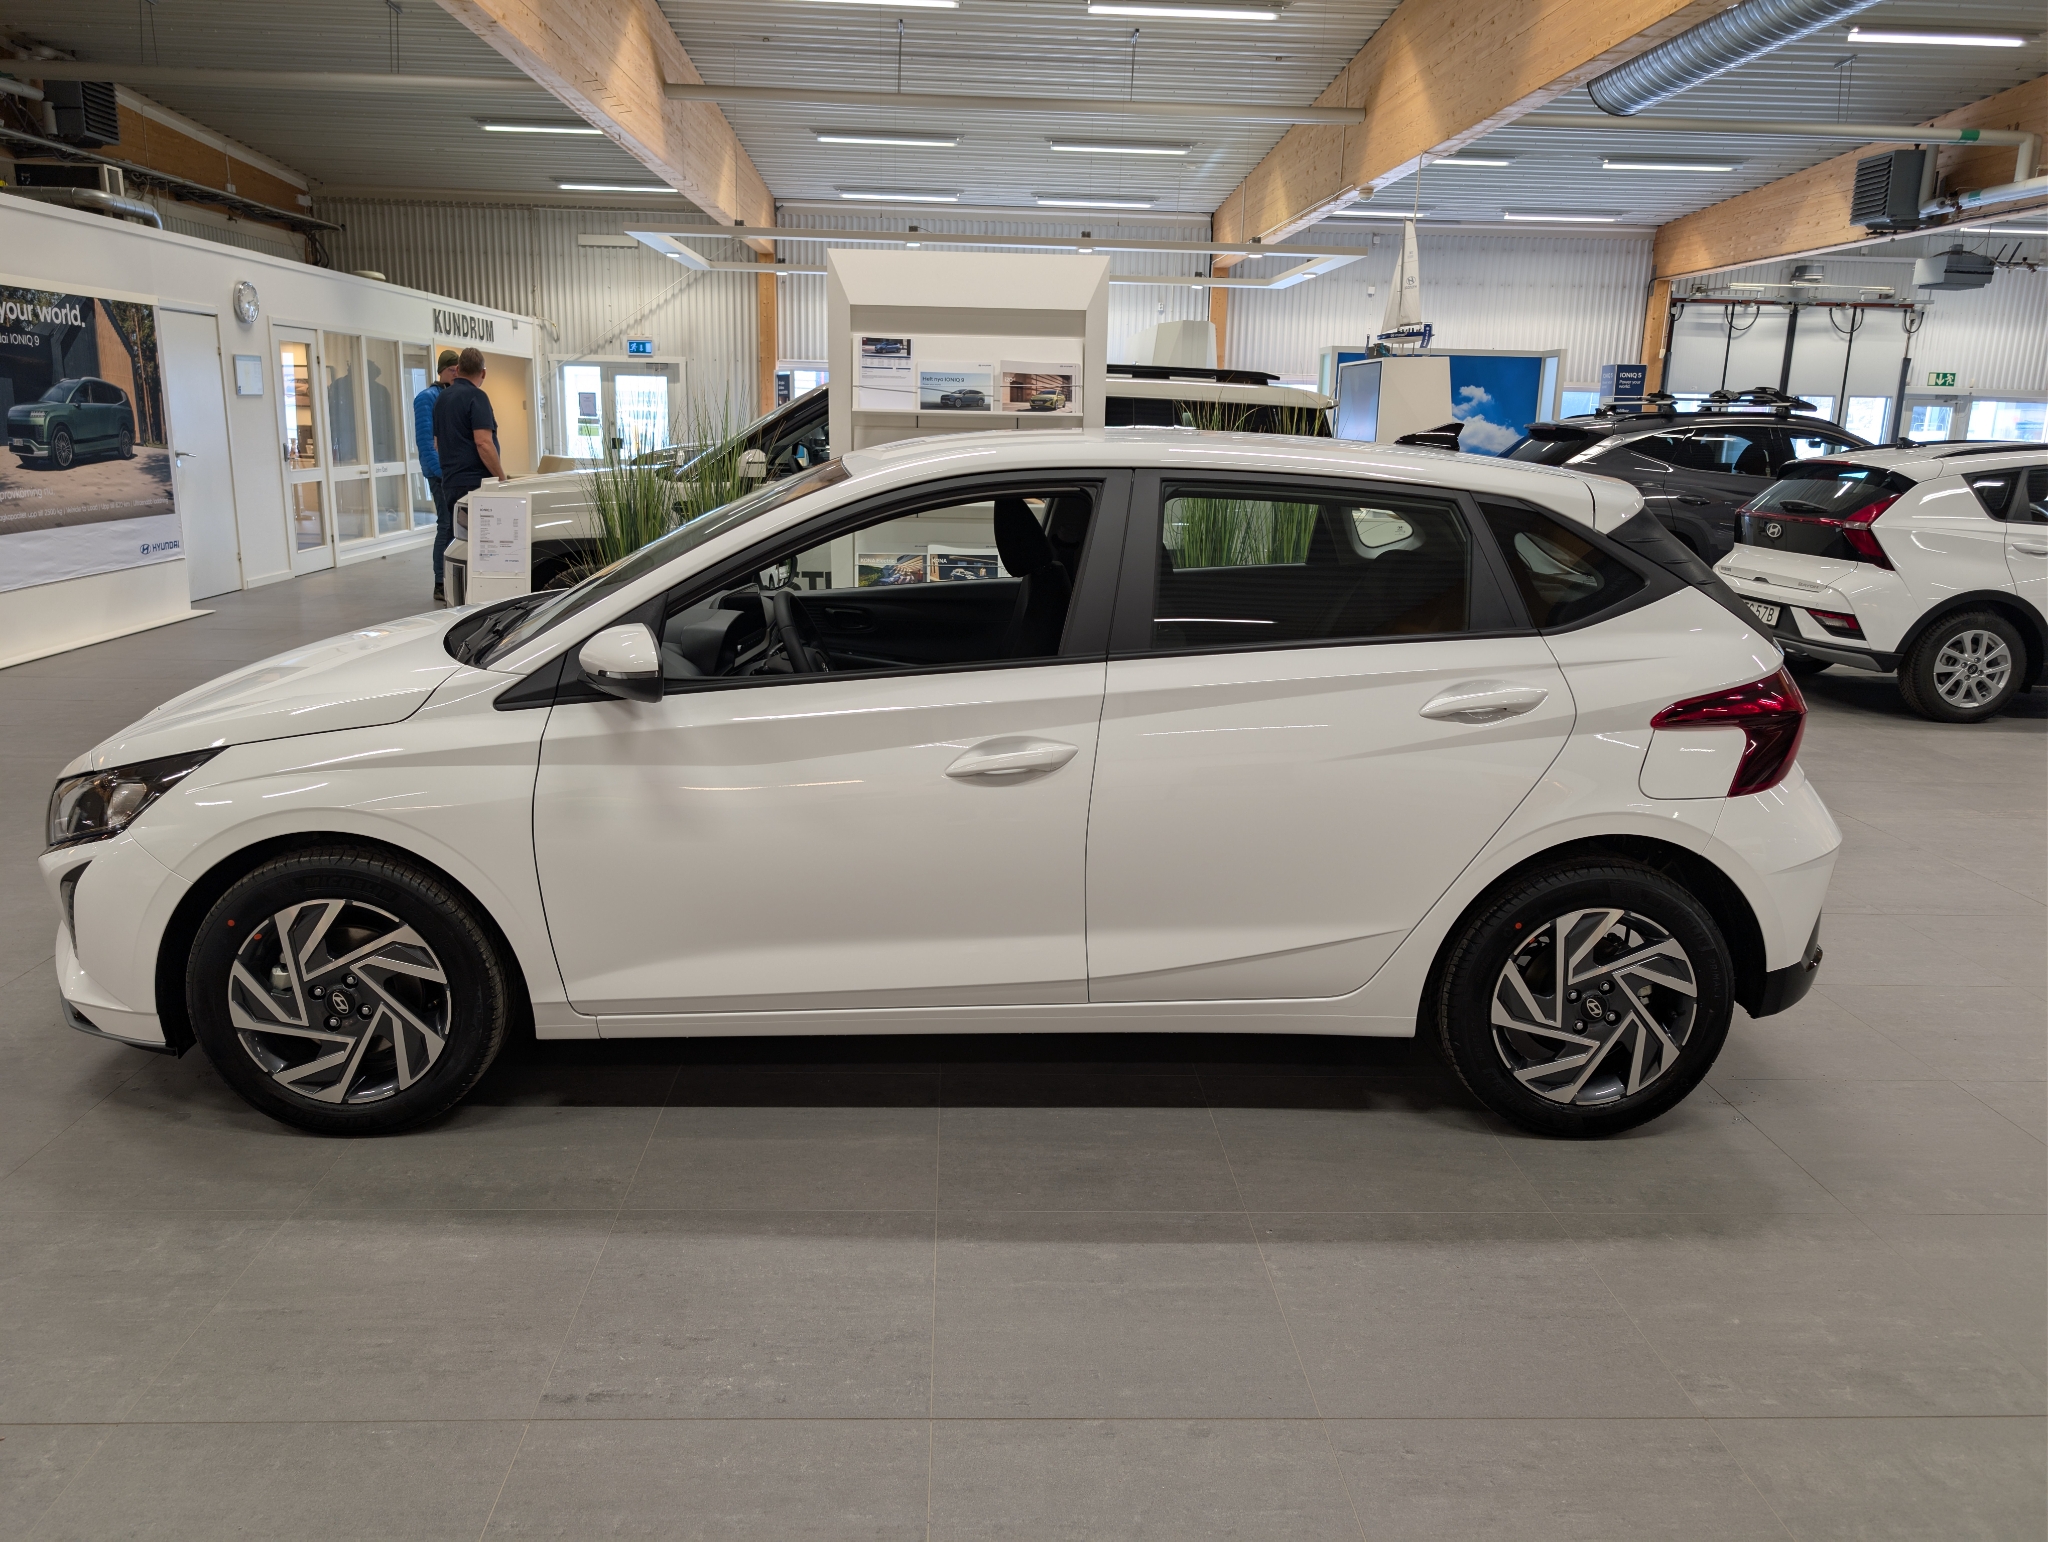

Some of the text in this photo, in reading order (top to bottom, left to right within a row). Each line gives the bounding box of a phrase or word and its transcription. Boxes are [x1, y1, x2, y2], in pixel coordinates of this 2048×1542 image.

[0, 301, 86, 327] your world.
[433, 308, 495, 342] KUNDRUM
[9, 333, 34, 347] IONIQ
[34, 335, 40, 346] 9
[152, 540, 180, 552] HYUNDAI
